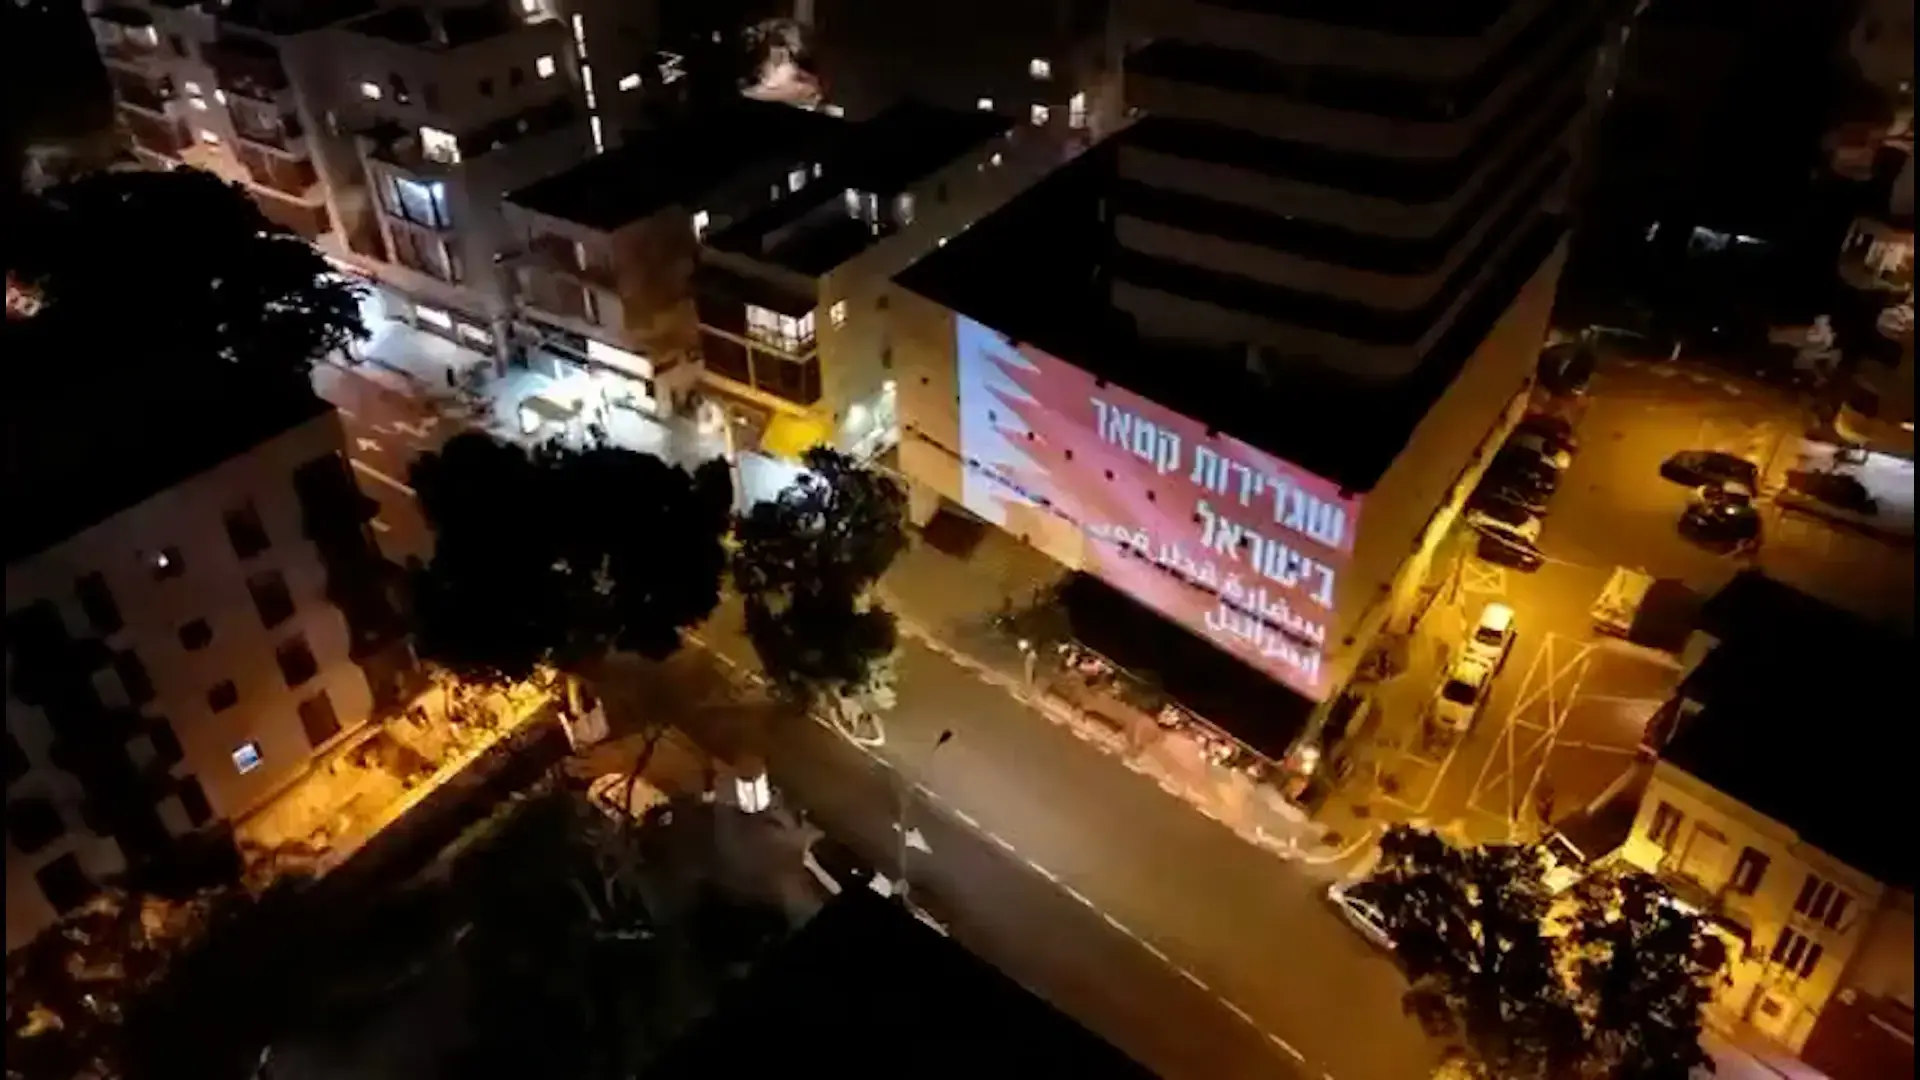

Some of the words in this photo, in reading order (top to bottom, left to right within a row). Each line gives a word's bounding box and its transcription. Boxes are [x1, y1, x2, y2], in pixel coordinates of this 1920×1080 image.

[1089, 396, 1181, 476] קטאר
[1190, 444, 1346, 549] שגרירות
[1195, 499, 1334, 610] בישראל
